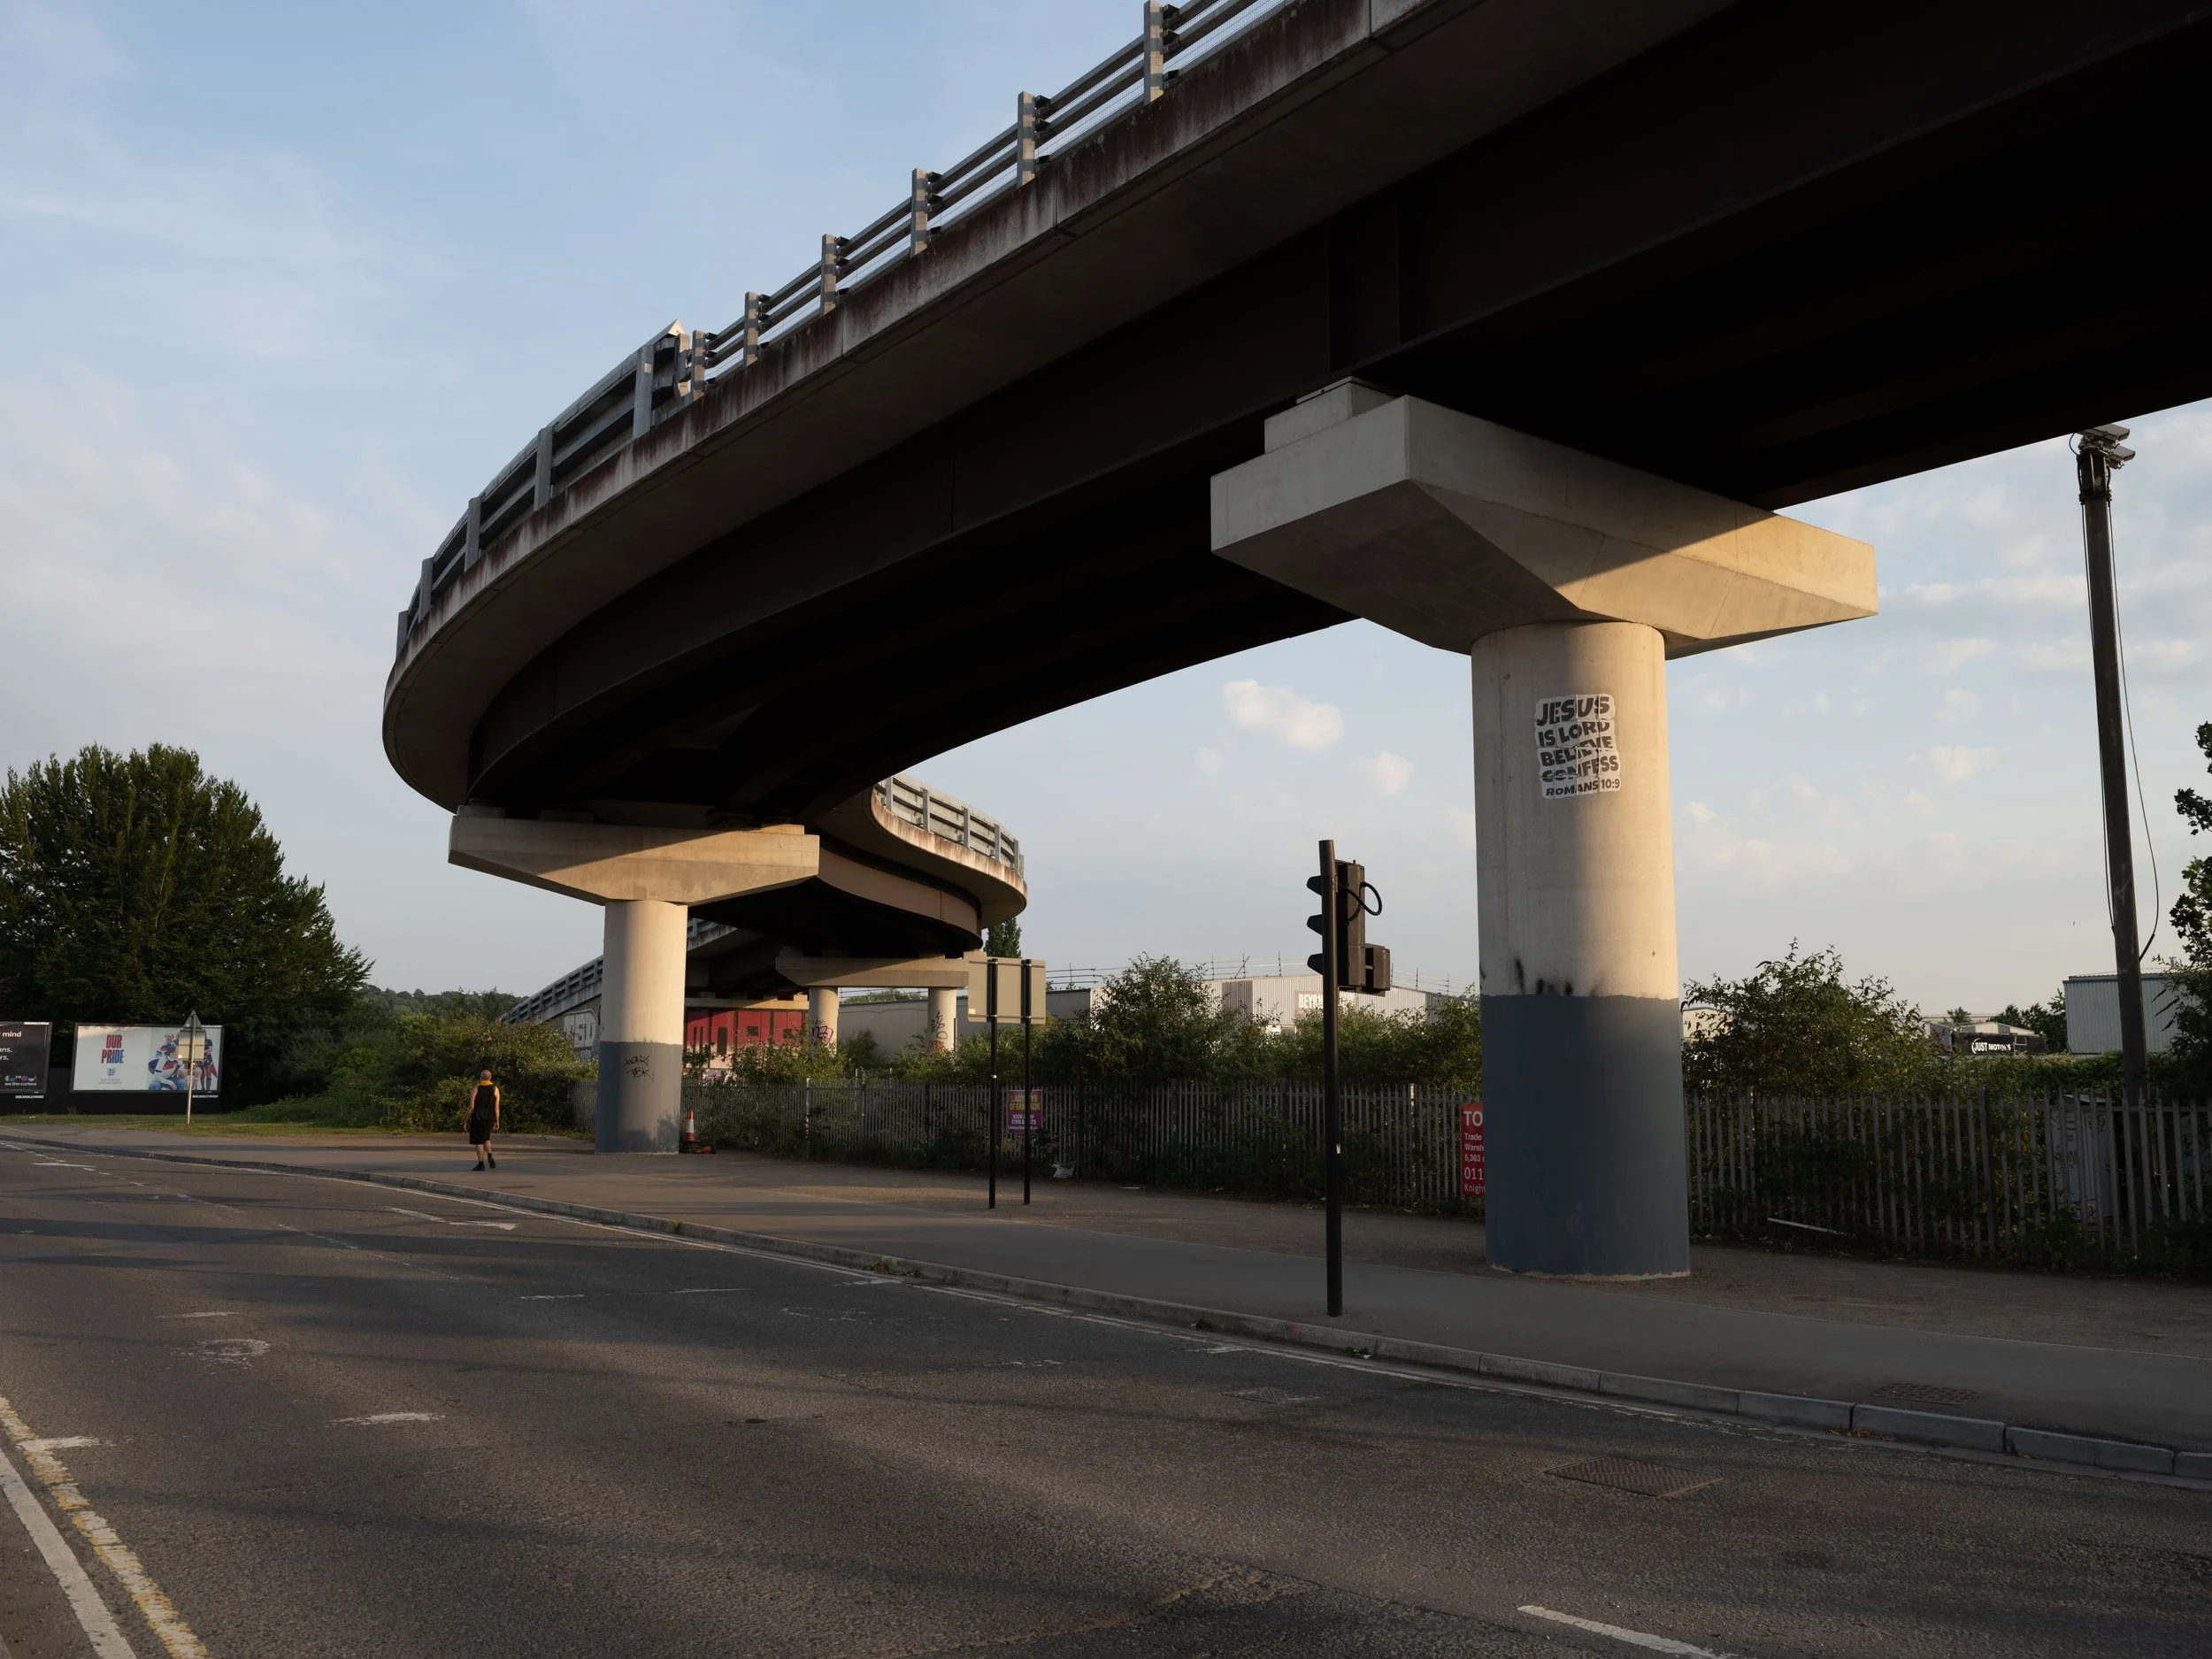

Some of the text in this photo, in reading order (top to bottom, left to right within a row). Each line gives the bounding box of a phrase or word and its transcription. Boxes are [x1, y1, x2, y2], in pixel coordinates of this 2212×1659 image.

[1536, 696, 1609, 726] JESUS
[1538, 719, 1610, 747] IS LORD
[1540, 736, 1613, 766] BELIEVE
[1546, 779, 1620, 796] ROMANS 10:9
[1298, 994, 1324, 1009] BEYON
[106, 1033, 122, 1048] OUR
[1974, 1042, 1987, 1051] JUST
[101, 1049, 124, 1064] PRIDE
[1463, 1110, 1483, 1126] TO
[1464, 1167, 1483, 1180] 011
